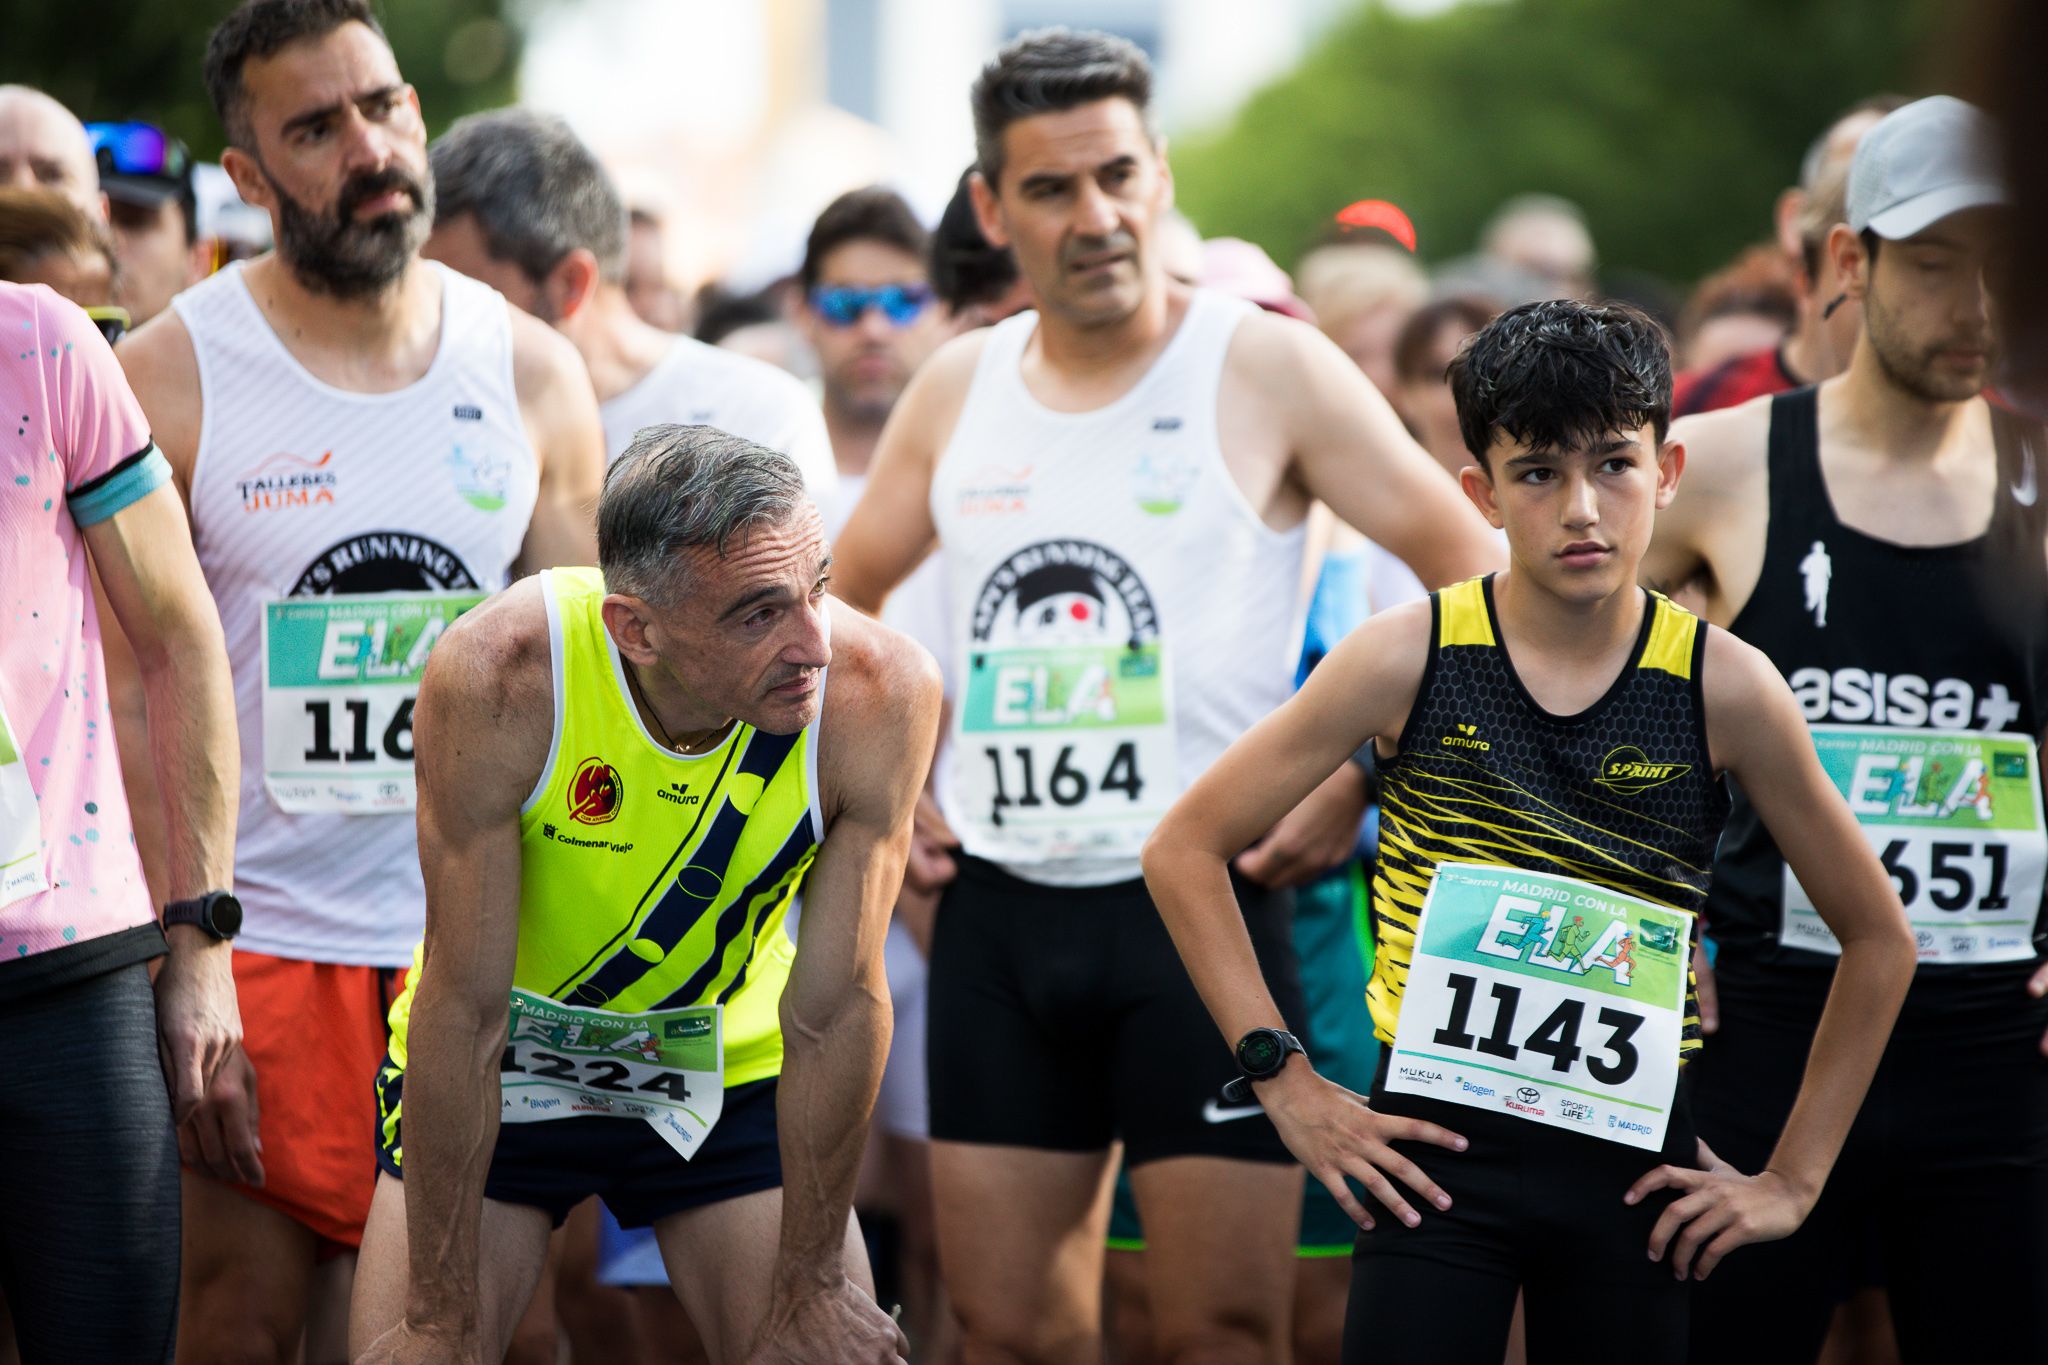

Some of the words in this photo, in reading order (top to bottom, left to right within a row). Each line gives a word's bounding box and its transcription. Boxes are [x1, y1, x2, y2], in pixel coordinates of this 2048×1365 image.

[992, 664, 1118, 726] ELA
[1442, 736, 1490, 751] amura
[984, 742, 1144, 807] 1164
[1607, 762, 1673, 779] SPRINT
[657, 787, 700, 805] amura
[1847, 754, 1993, 821] ELA
[557, 834, 609, 848] Colmenar
[610, 841, 633, 853] Viejo
[1502, 879, 1571, 903] MADRID
[1574, 895, 1607, 911] CON
[1609, 904, 1628, 918] LA
[1475, 894, 1633, 987] ELA
[521, 1003, 585, 1024] MADRID
[590, 1018, 624, 1029] CON
[630, 1020, 649, 1030] LA
[1433, 973, 1646, 1086] 1143
[501, 1045, 691, 1103] 1224
[1400, 1067, 1443, 1081] MUKUA
[1463, 1081, 1495, 1096] Biogen
[1560, 1099, 1588, 1112] SPORT
[1562, 1108, 1584, 1120] LIFE
[1617, 1122, 1653, 1135] MADRID
